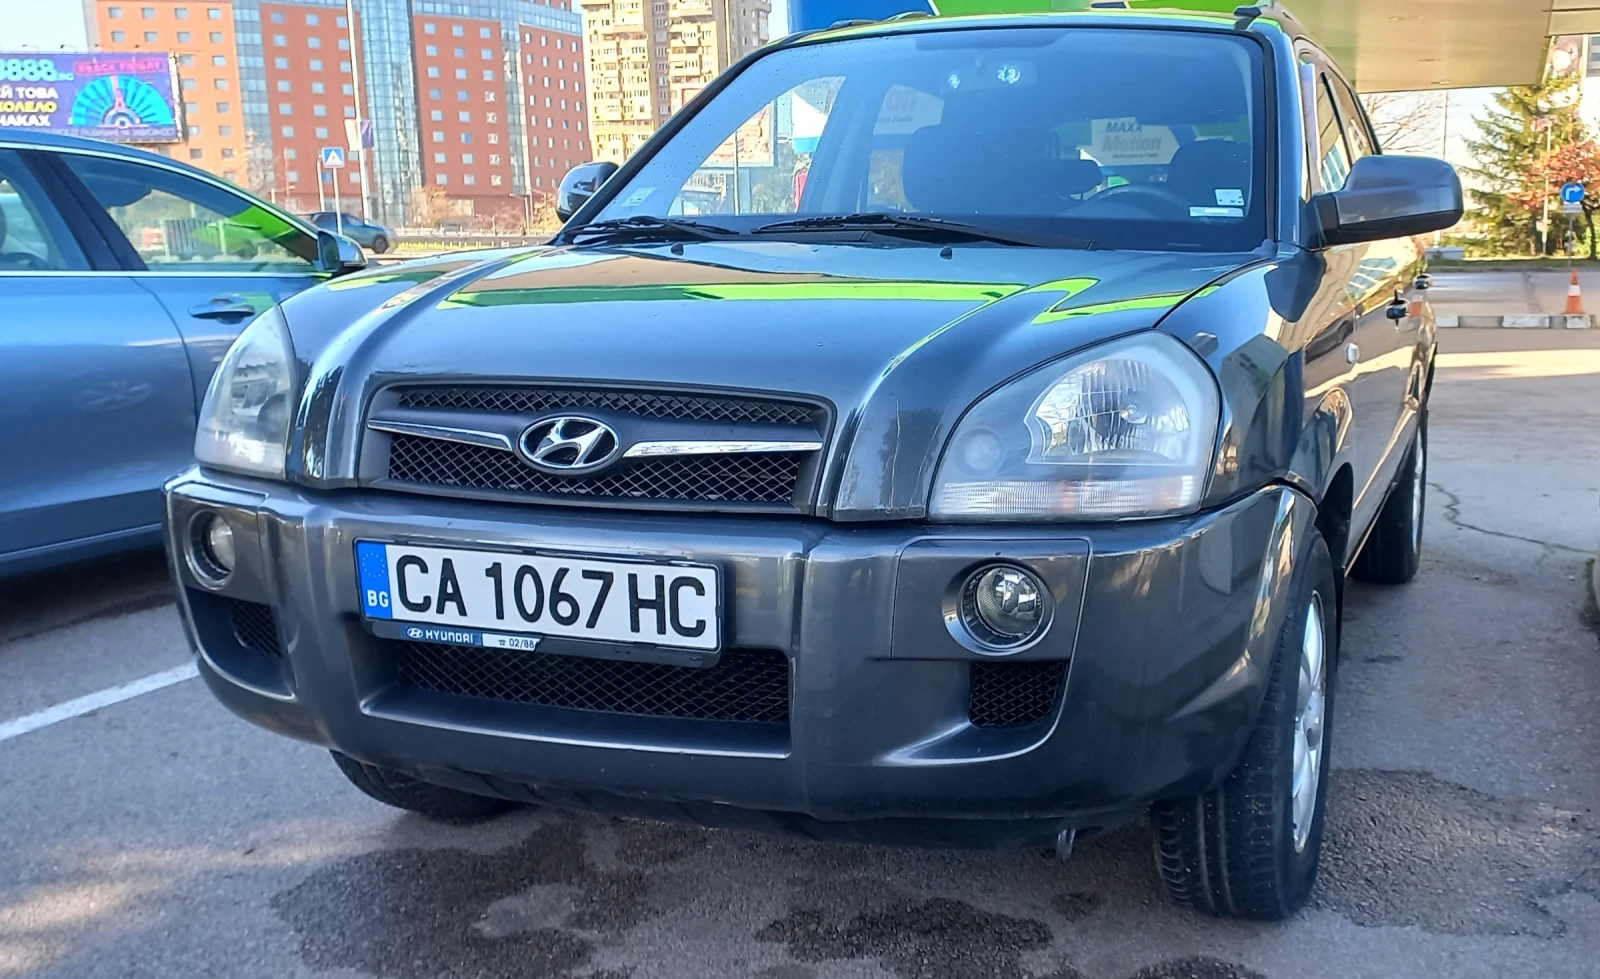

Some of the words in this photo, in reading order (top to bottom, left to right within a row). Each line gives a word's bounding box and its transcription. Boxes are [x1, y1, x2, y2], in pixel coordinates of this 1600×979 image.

[15, 86, 58, 99] ТОВА
[1102, 133, 1162, 152] Motion
[367, 589, 390, 609] BG
[396, 555, 468, 617] CA
[485, 561, 614, 627] 1067
[627, 573, 706, 638] HC
[425, 629, 474, 645] HYUNDAI
